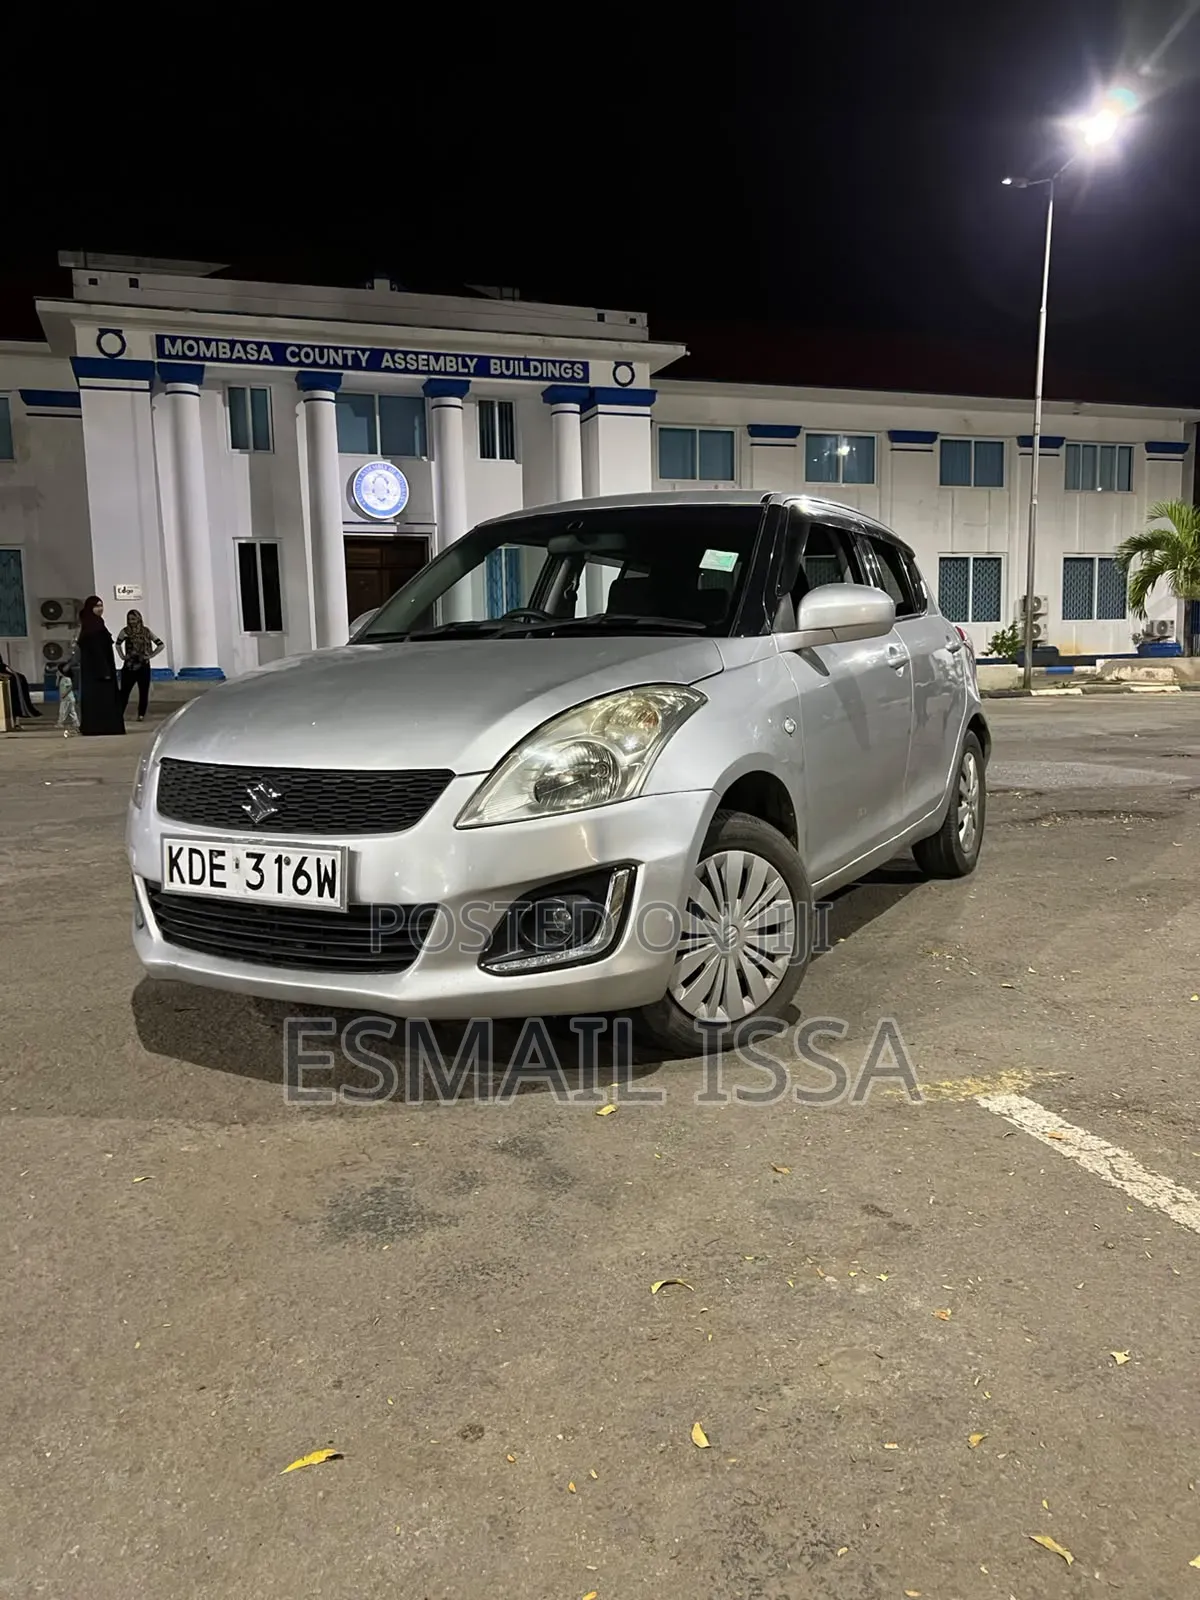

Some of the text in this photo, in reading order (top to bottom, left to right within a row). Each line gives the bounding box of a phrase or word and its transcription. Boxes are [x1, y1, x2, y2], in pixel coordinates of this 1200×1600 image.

[163, 337, 584, 379] MOMBASA COUNTY ASSEMBLY BUILDINGS
[168, 845, 337, 899] KDE 316W
